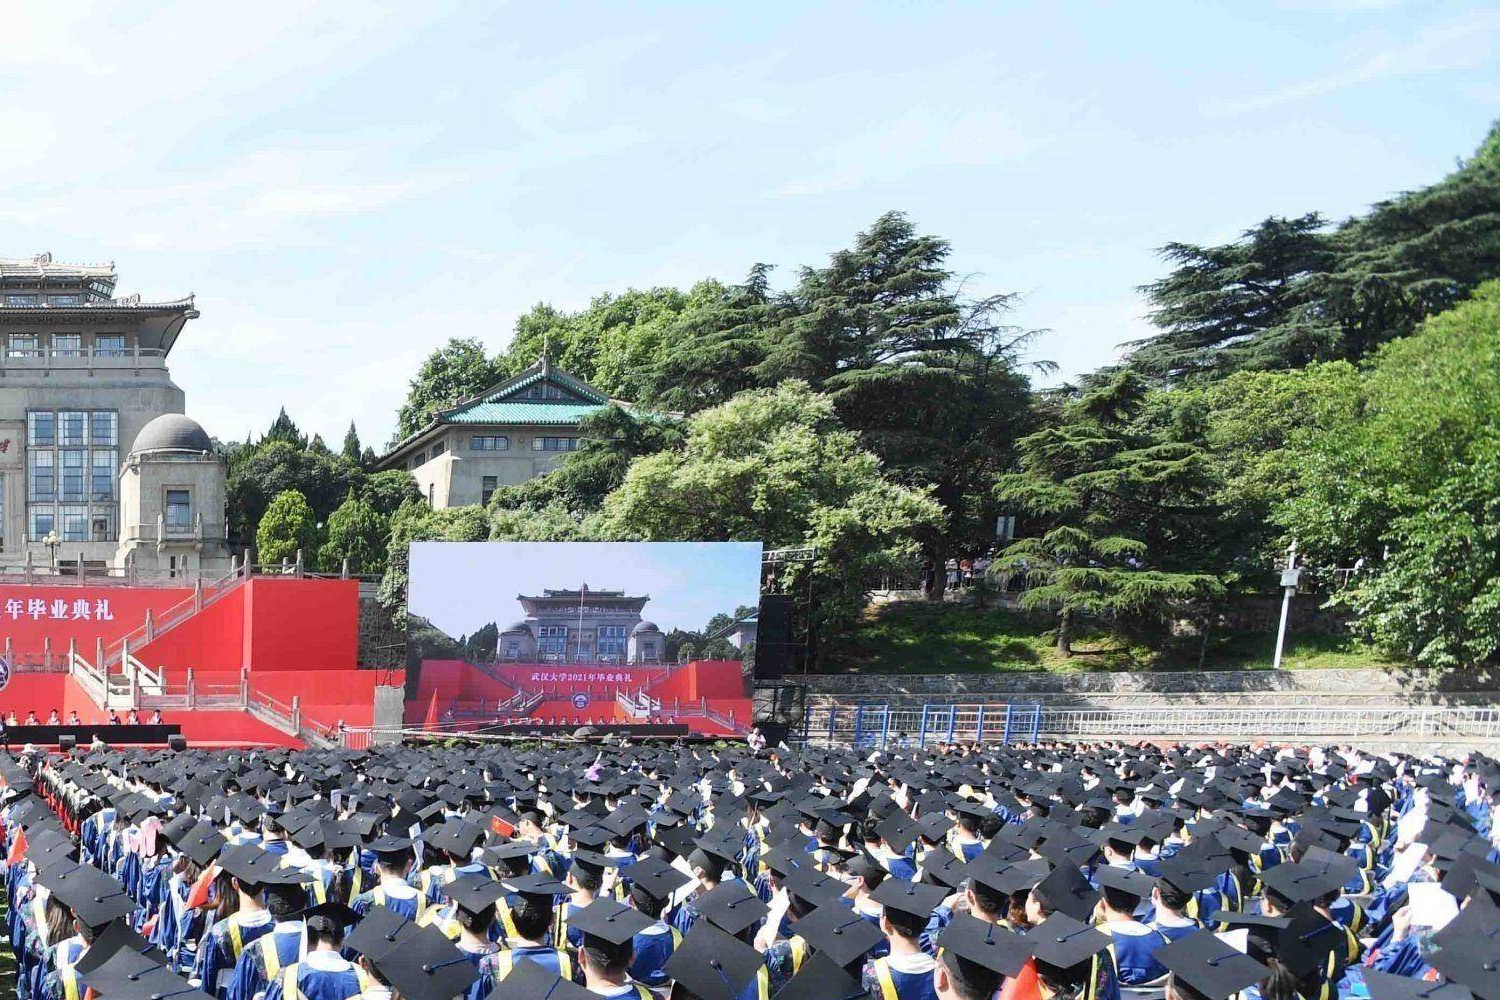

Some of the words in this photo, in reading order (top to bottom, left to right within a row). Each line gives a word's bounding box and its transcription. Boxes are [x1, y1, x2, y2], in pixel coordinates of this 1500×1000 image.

[531, 672, 633, 682] 武汉大学2021年毕业典礼
